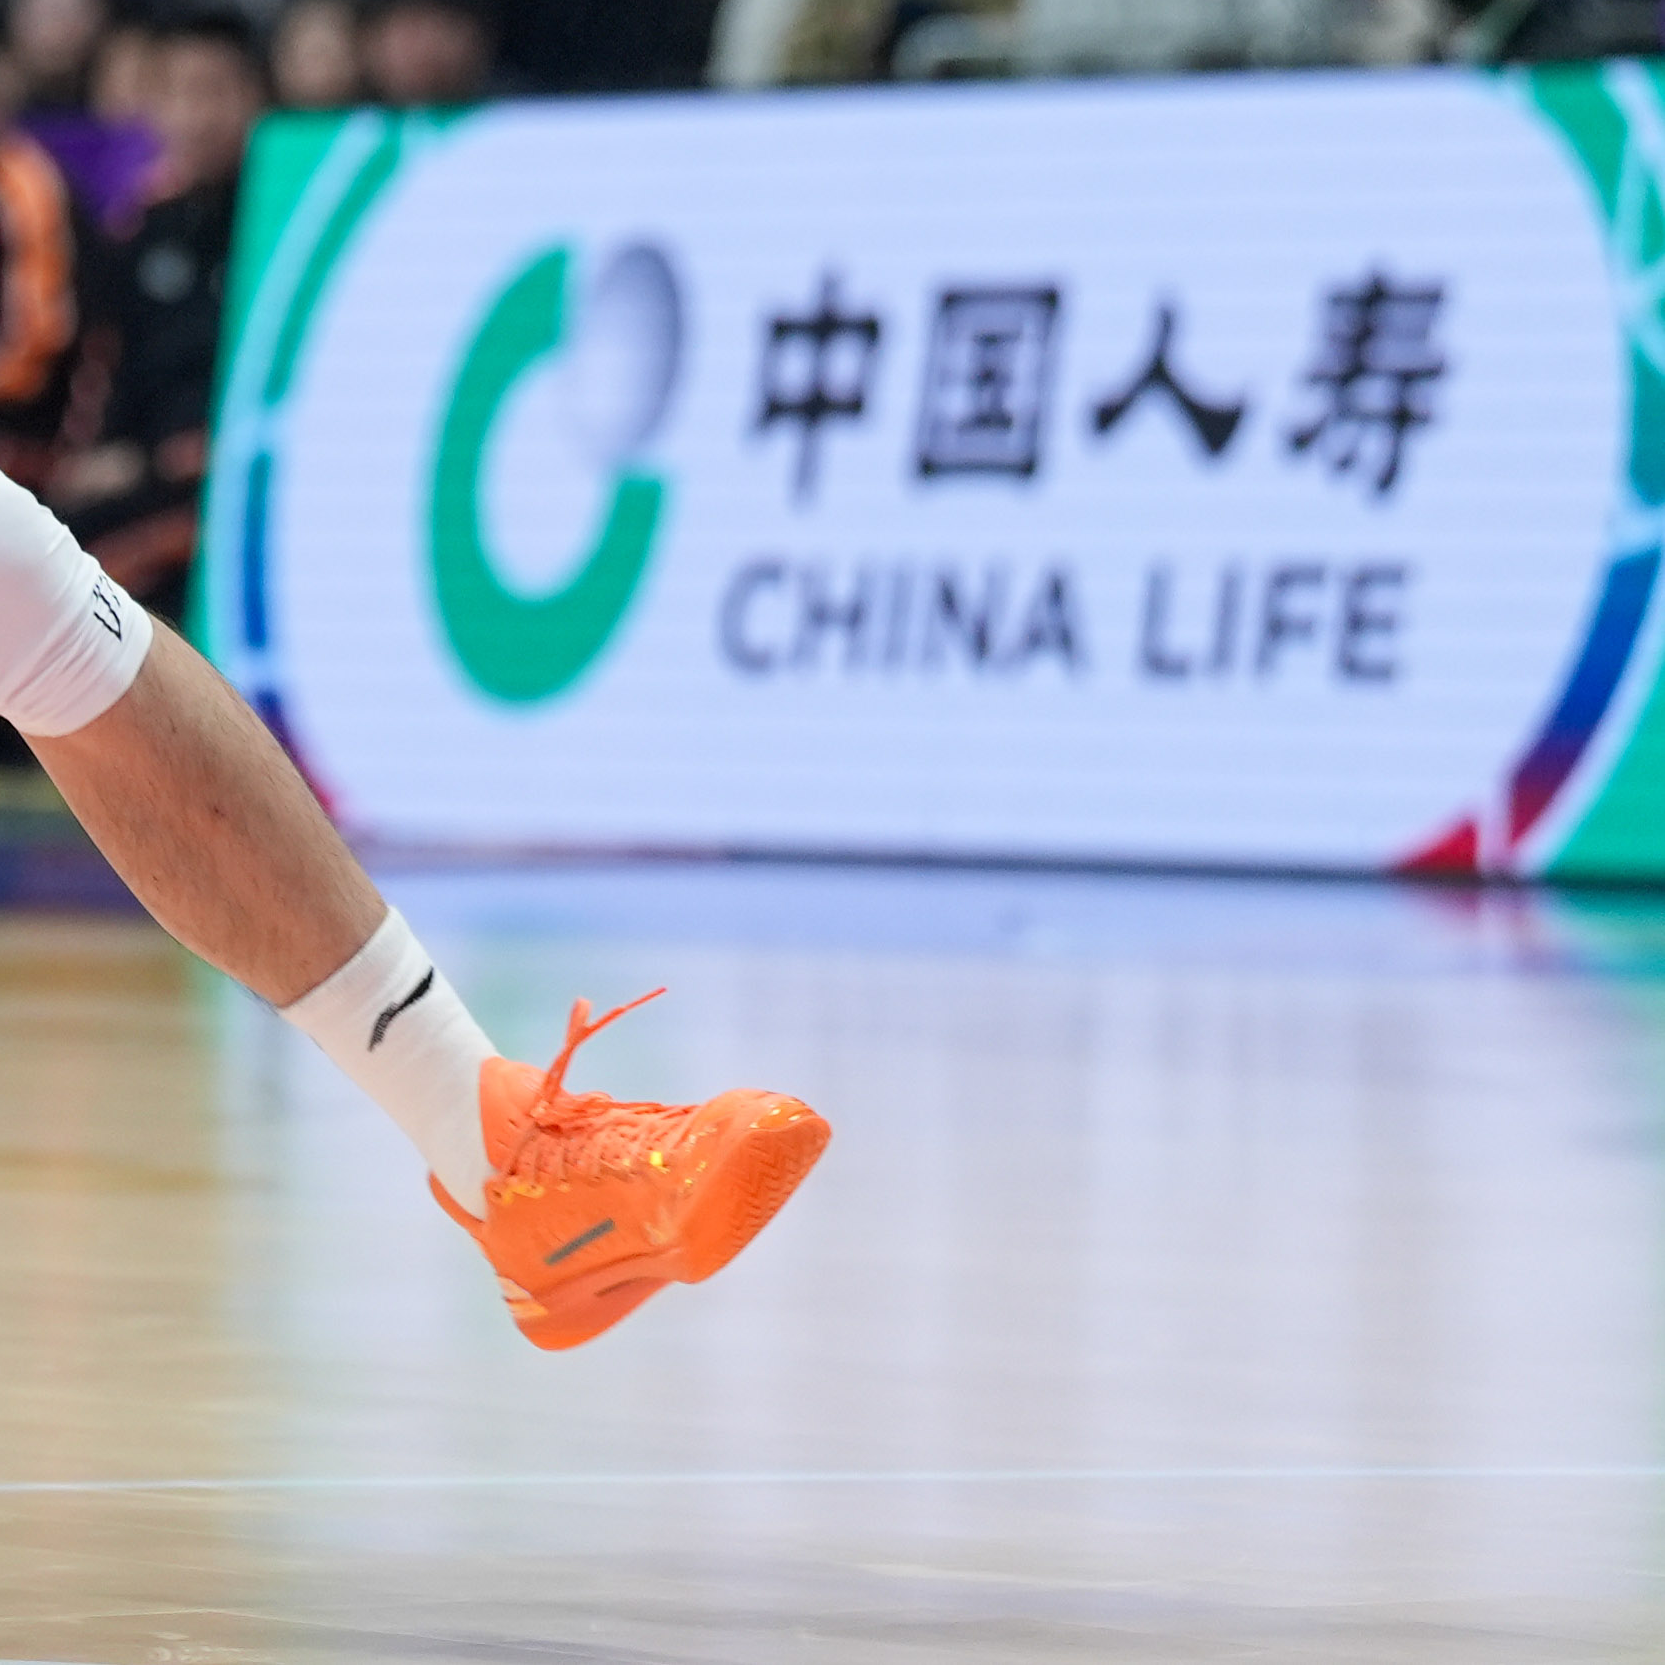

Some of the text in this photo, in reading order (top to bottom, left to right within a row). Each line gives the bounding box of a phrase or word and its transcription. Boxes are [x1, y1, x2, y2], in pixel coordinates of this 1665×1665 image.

[749, 259, 1451, 506] 中国人寿
[716, 560, 1412, 684] CHINA LIFE
